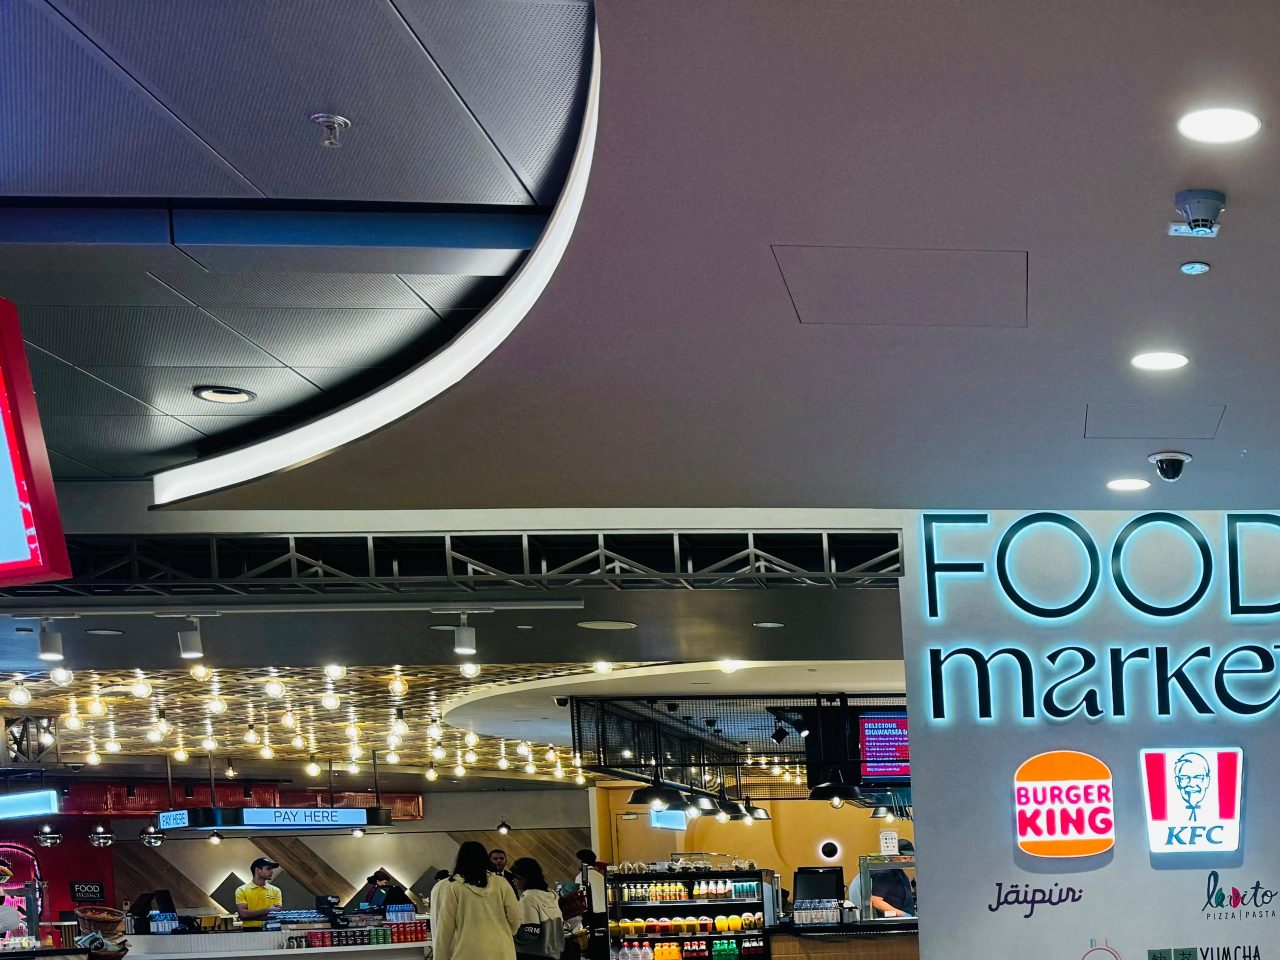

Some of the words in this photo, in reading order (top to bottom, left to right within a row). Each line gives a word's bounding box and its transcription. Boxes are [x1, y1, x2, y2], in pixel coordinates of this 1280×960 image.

[1016, 784, 1112, 806] BURGER
[162, 813, 172, 826] PAY
[172, 811, 186, 826] HERE
[274, 811, 298, 822] PAY
[304, 811, 338, 822] HERE
[1017, 806, 1114, 837] KING
[1165, 825, 1225, 846] KFC
[75, 885, 100, 893] FOOD
